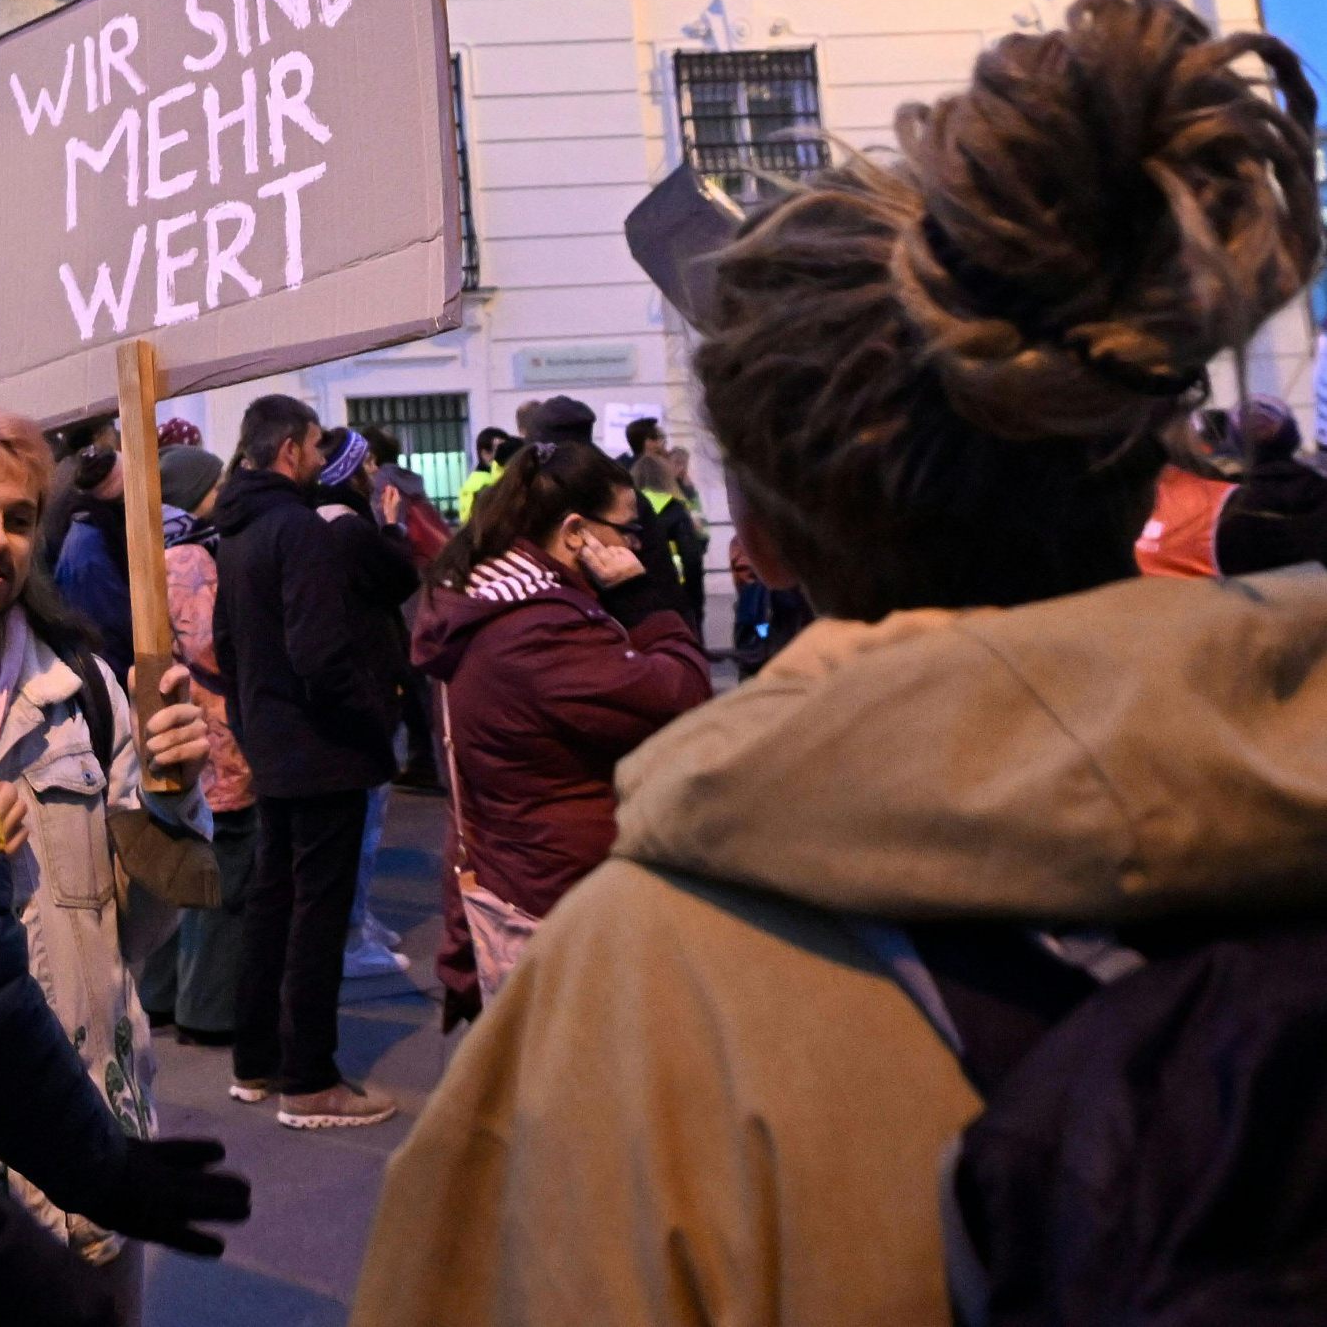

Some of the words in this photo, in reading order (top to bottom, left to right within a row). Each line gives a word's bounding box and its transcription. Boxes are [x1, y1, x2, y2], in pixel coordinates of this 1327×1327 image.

[9, 13, 148, 136] WIR
[64, 50, 333, 233] MEHR
[58, 161, 328, 341] WERT
